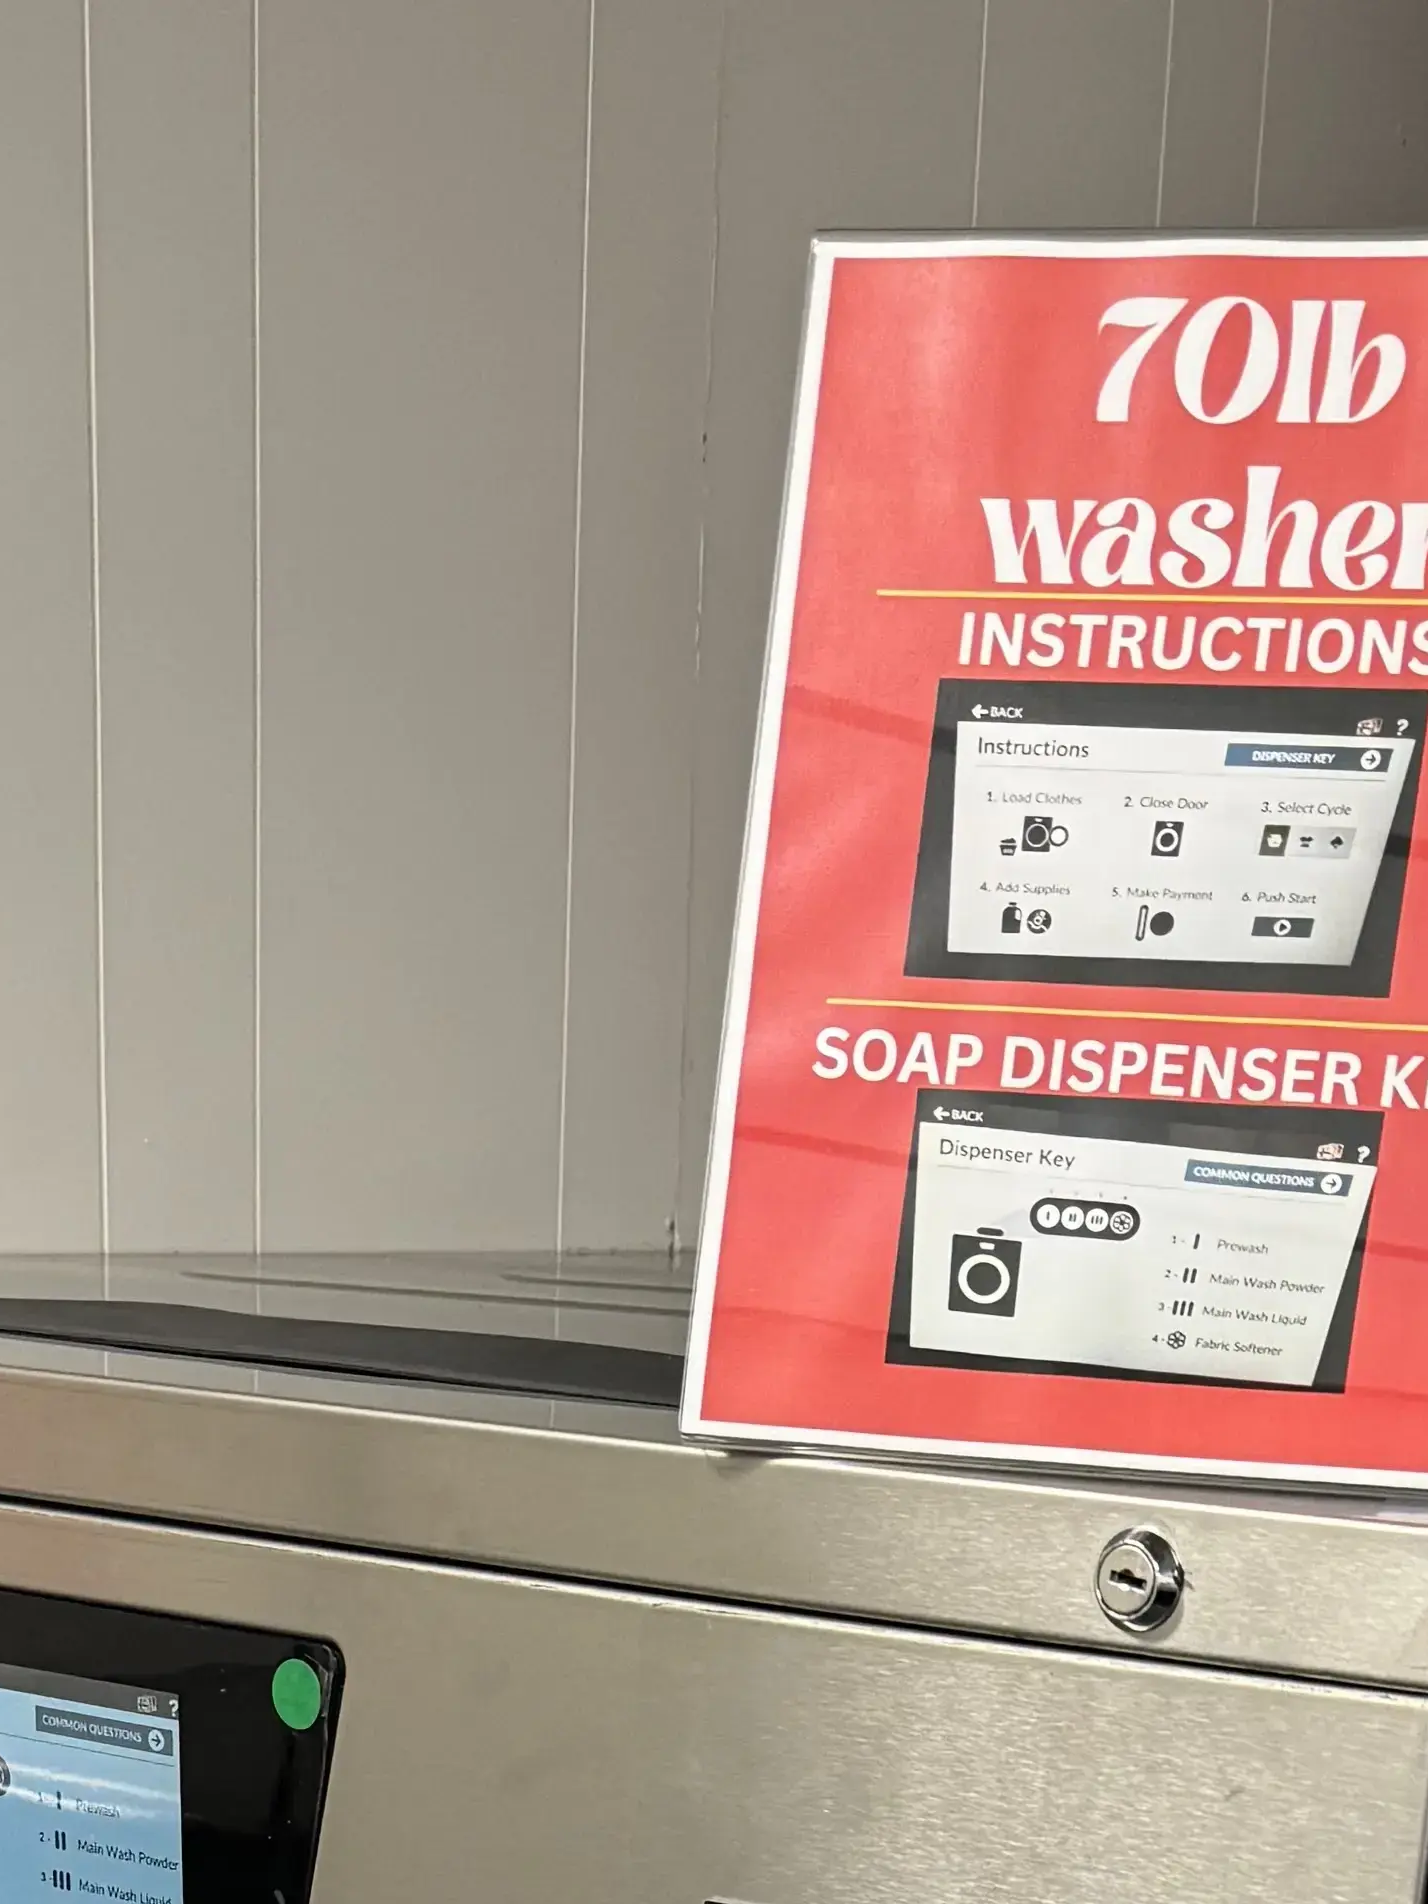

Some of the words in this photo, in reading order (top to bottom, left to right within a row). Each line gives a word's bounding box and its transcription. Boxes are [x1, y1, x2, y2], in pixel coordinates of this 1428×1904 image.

[1095, 296, 1407, 424] 70lb
[990, 706, 1024, 719] BACK
[978, 737, 1089, 758] Instructions
[1252, 751, 1312, 764] DISPENSER
[1313, 753, 1336, 765] KEY
[1002, 792, 1032, 804] Load
[1035, 792, 1083, 805] Clothes
[1139, 797, 1173, 808] Close
[1177, 798, 1209, 810] Door
[1277, 802, 1314, 814] Select
[1317, 803, 1352, 816] Cycle
[995, 881, 1020, 893] Add
[1023, 883, 1071, 896] Supplies
[1127, 887, 1160, 899] Make
[1162, 888, 1213, 900] Payment
[1257, 892, 1286, 903] Push
[1288, 892, 1317, 904] Start
[811, 1026, 983, 1086] SOAP
[1000, 1034, 1362, 1105] DISPENSER
[951, 1109, 984, 1123] BACK
[939, 1138, 1033, 1164] Dispenser
[1039, 1149, 1076, 1170] Key
[1193, 1166, 1250, 1182] COMMON
[1251, 1171, 1316, 1188] QUESTIONS
[1217, 1238, 1269, 1254] Prewash
[1209, 1273, 1240, 1286] Main
[1243, 1277, 1277, 1290] Wash
[1279, 1280, 1325, 1294] Powder
[1202, 1306, 1232, 1319] Main
[1235, 1309, 1269, 1323] Wash
[1271, 1313, 1308, 1326] Liquid
[1195, 1337, 1230, 1352] Fabric
[1233, 1341, 1283, 1356] Softener
[42, 1714, 88, 1733] COMMON
[89, 1723, 142, 1743] QUESTIONS
[77, 1839, 104, 1855] Main
[105, 1845, 136, 1863] Wash
[138, 1852, 179, 1871] Powder
[79, 1878, 105, 1895] Main
[107, 1885, 137, 1903] Wash
